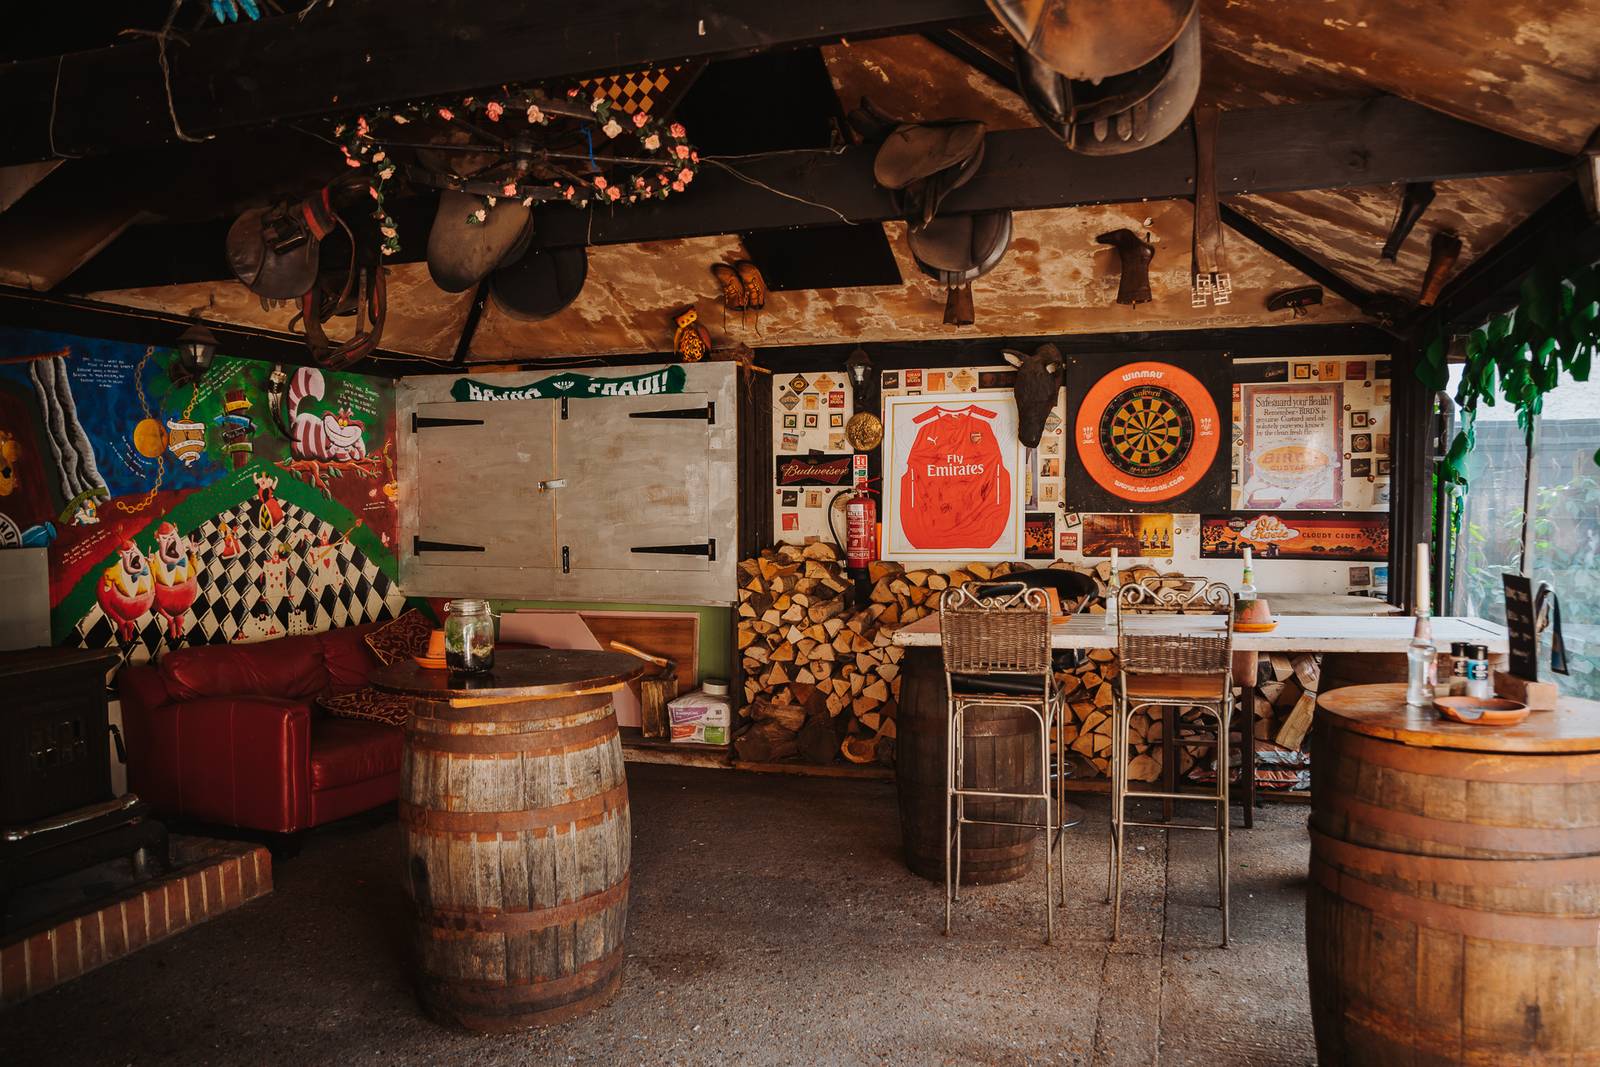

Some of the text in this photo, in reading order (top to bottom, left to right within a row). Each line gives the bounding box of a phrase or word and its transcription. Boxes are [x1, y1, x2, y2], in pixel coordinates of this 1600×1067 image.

[947, 454, 964, 464] Fly
[781, 464, 849, 477] Budweiser
[927, 463, 985, 477] Emirates
[1302, 531, 1362, 540] CLOUDY CIDER
